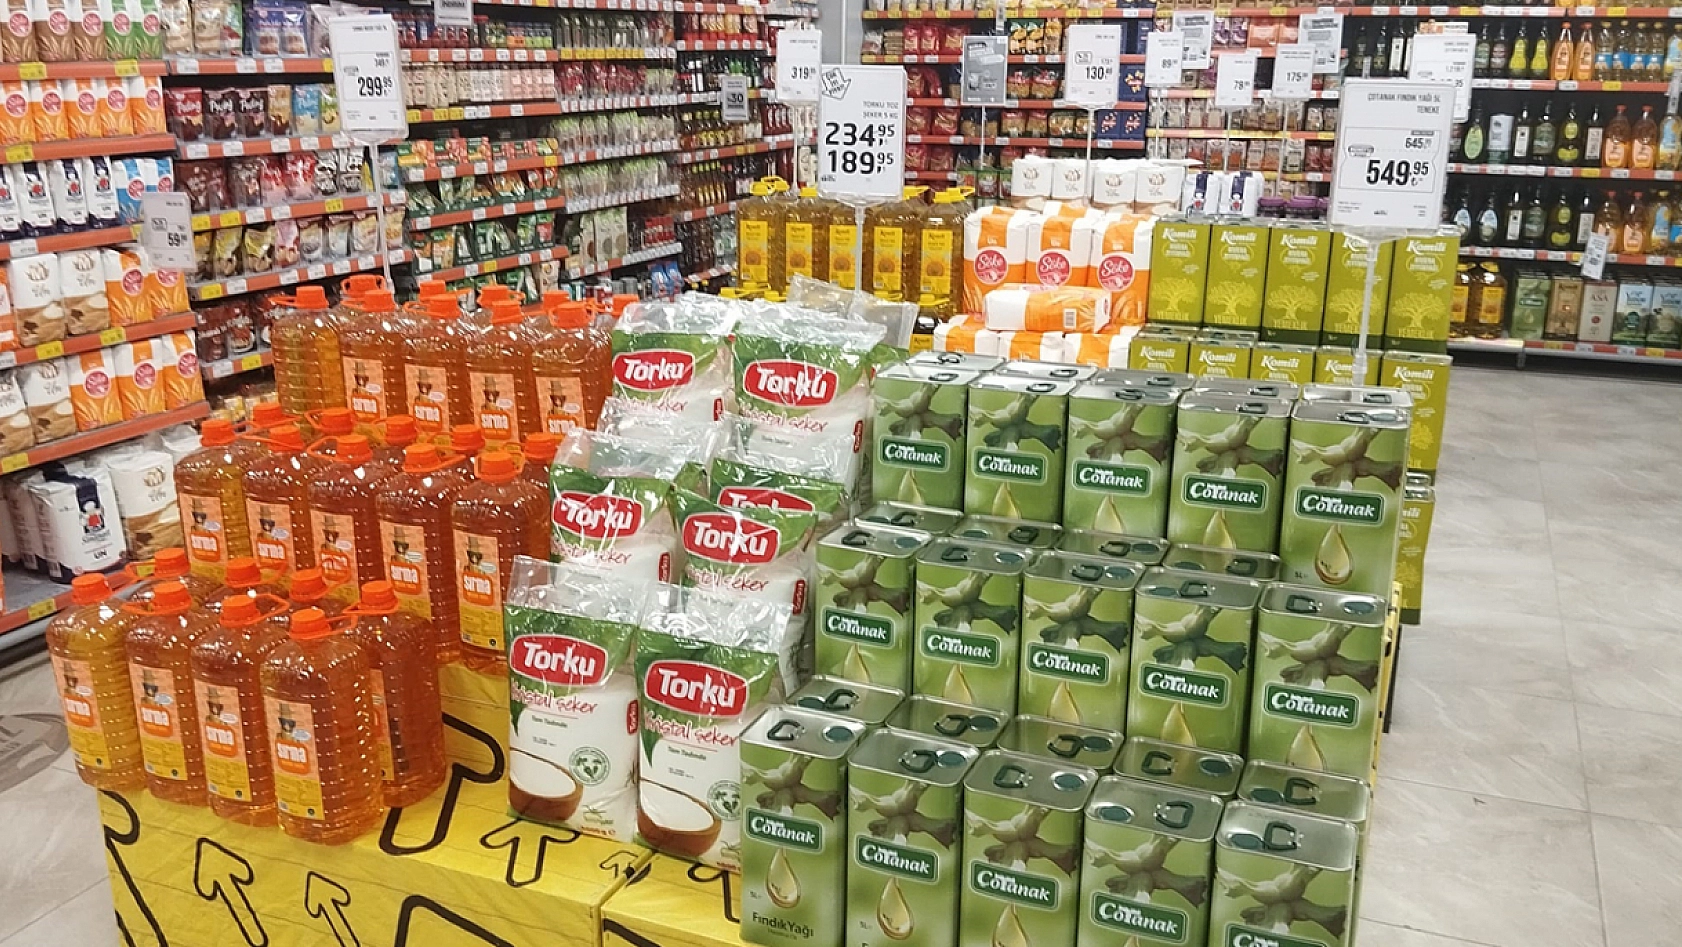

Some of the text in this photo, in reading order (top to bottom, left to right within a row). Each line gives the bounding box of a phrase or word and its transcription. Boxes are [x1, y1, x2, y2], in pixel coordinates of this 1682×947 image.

[1163, 227, 1197, 243] Komili
[1221, 231, 1257, 244] Komili
[1280, 234, 1319, 249] Komili
[1406, 240, 1447, 255] Komili
[1140, 345, 1176, 362] Komili
[1199, 350, 1237, 367] Komili
[623, 357, 685, 382] Torku
[1261, 355, 1300, 372] Komili
[757, 367, 828, 399] Torku
[1392, 366, 1435, 383] Komili
[561, 498, 634, 530] Torku
[693, 521, 768, 557] Torku
[523, 641, 597, 677] Torku
[658, 667, 737, 708] Torku
